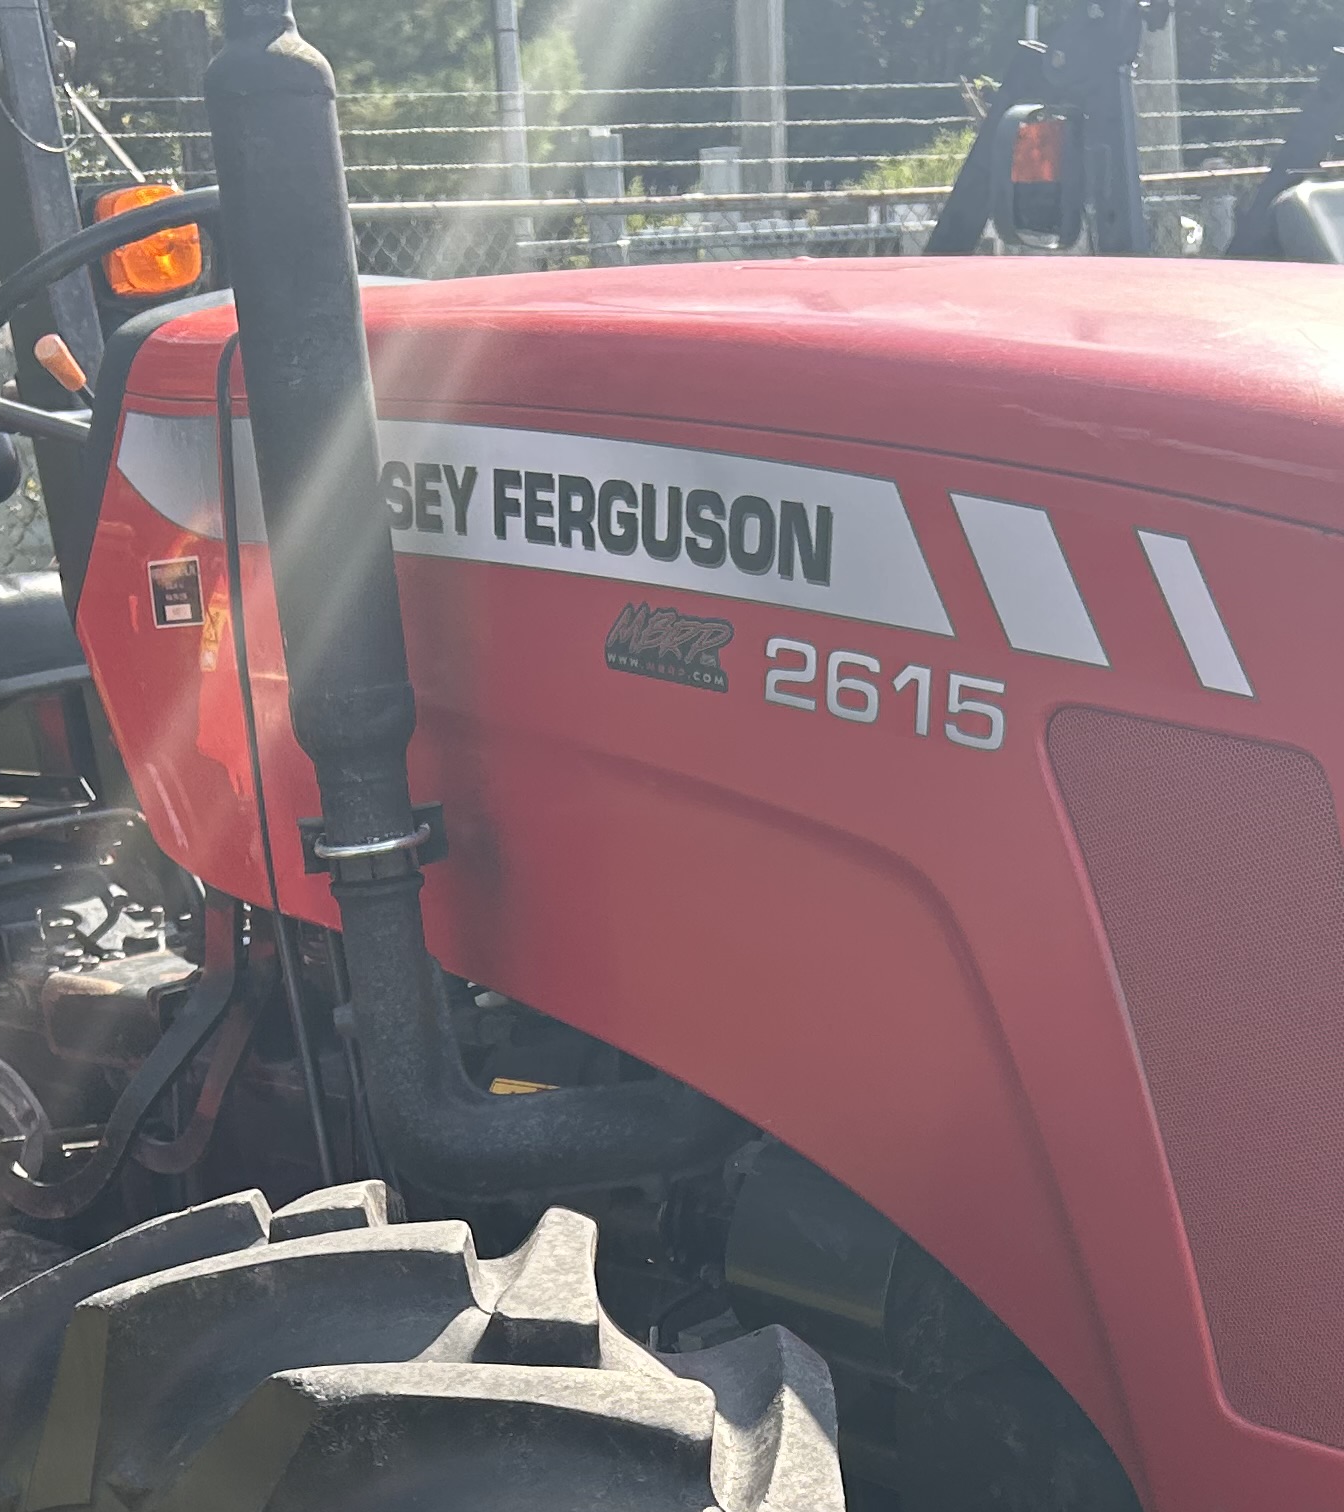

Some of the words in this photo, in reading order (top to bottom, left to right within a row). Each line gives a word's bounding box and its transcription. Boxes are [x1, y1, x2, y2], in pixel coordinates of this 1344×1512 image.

[377, 460, 479, 537] SEY
[492, 467, 834, 587] FERGUSON
[606, 604, 733, 665] MBRP
[764, 636, 1006, 751] 2615
